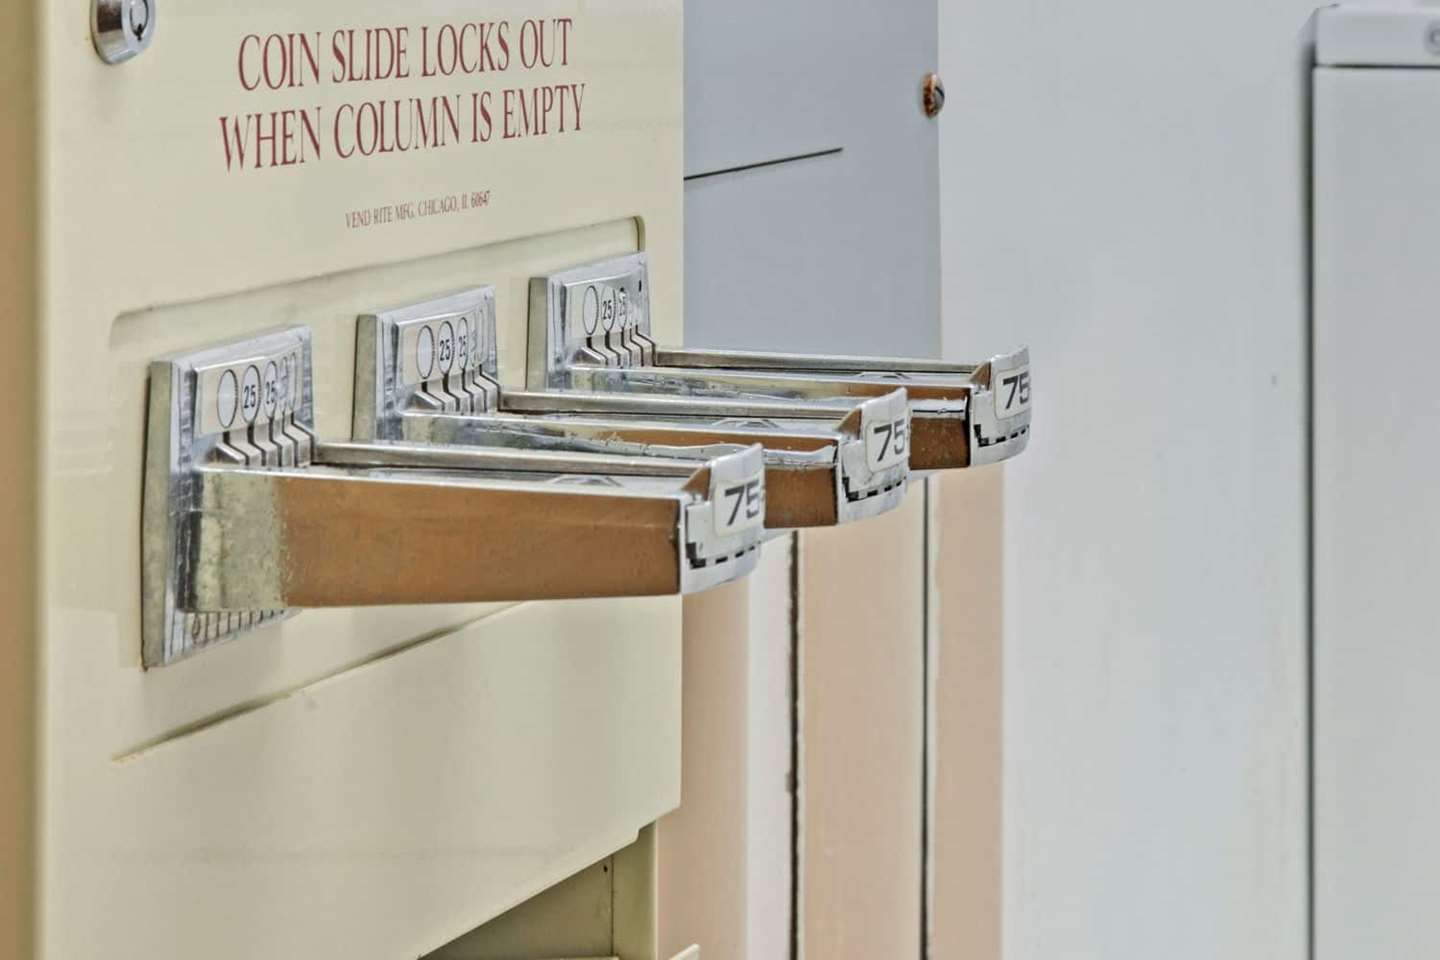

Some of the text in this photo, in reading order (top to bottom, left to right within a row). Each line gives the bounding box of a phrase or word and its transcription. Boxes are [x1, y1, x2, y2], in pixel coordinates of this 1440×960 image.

[238, 17, 573, 91] COIN SLIDE LOCKS OUT
[219, 83, 586, 173] WHEN COLUMN IS EMPTY
[602, 300, 613, 320] 25
[439, 338, 451, 361] 25
[243, 384, 257, 410] 25
